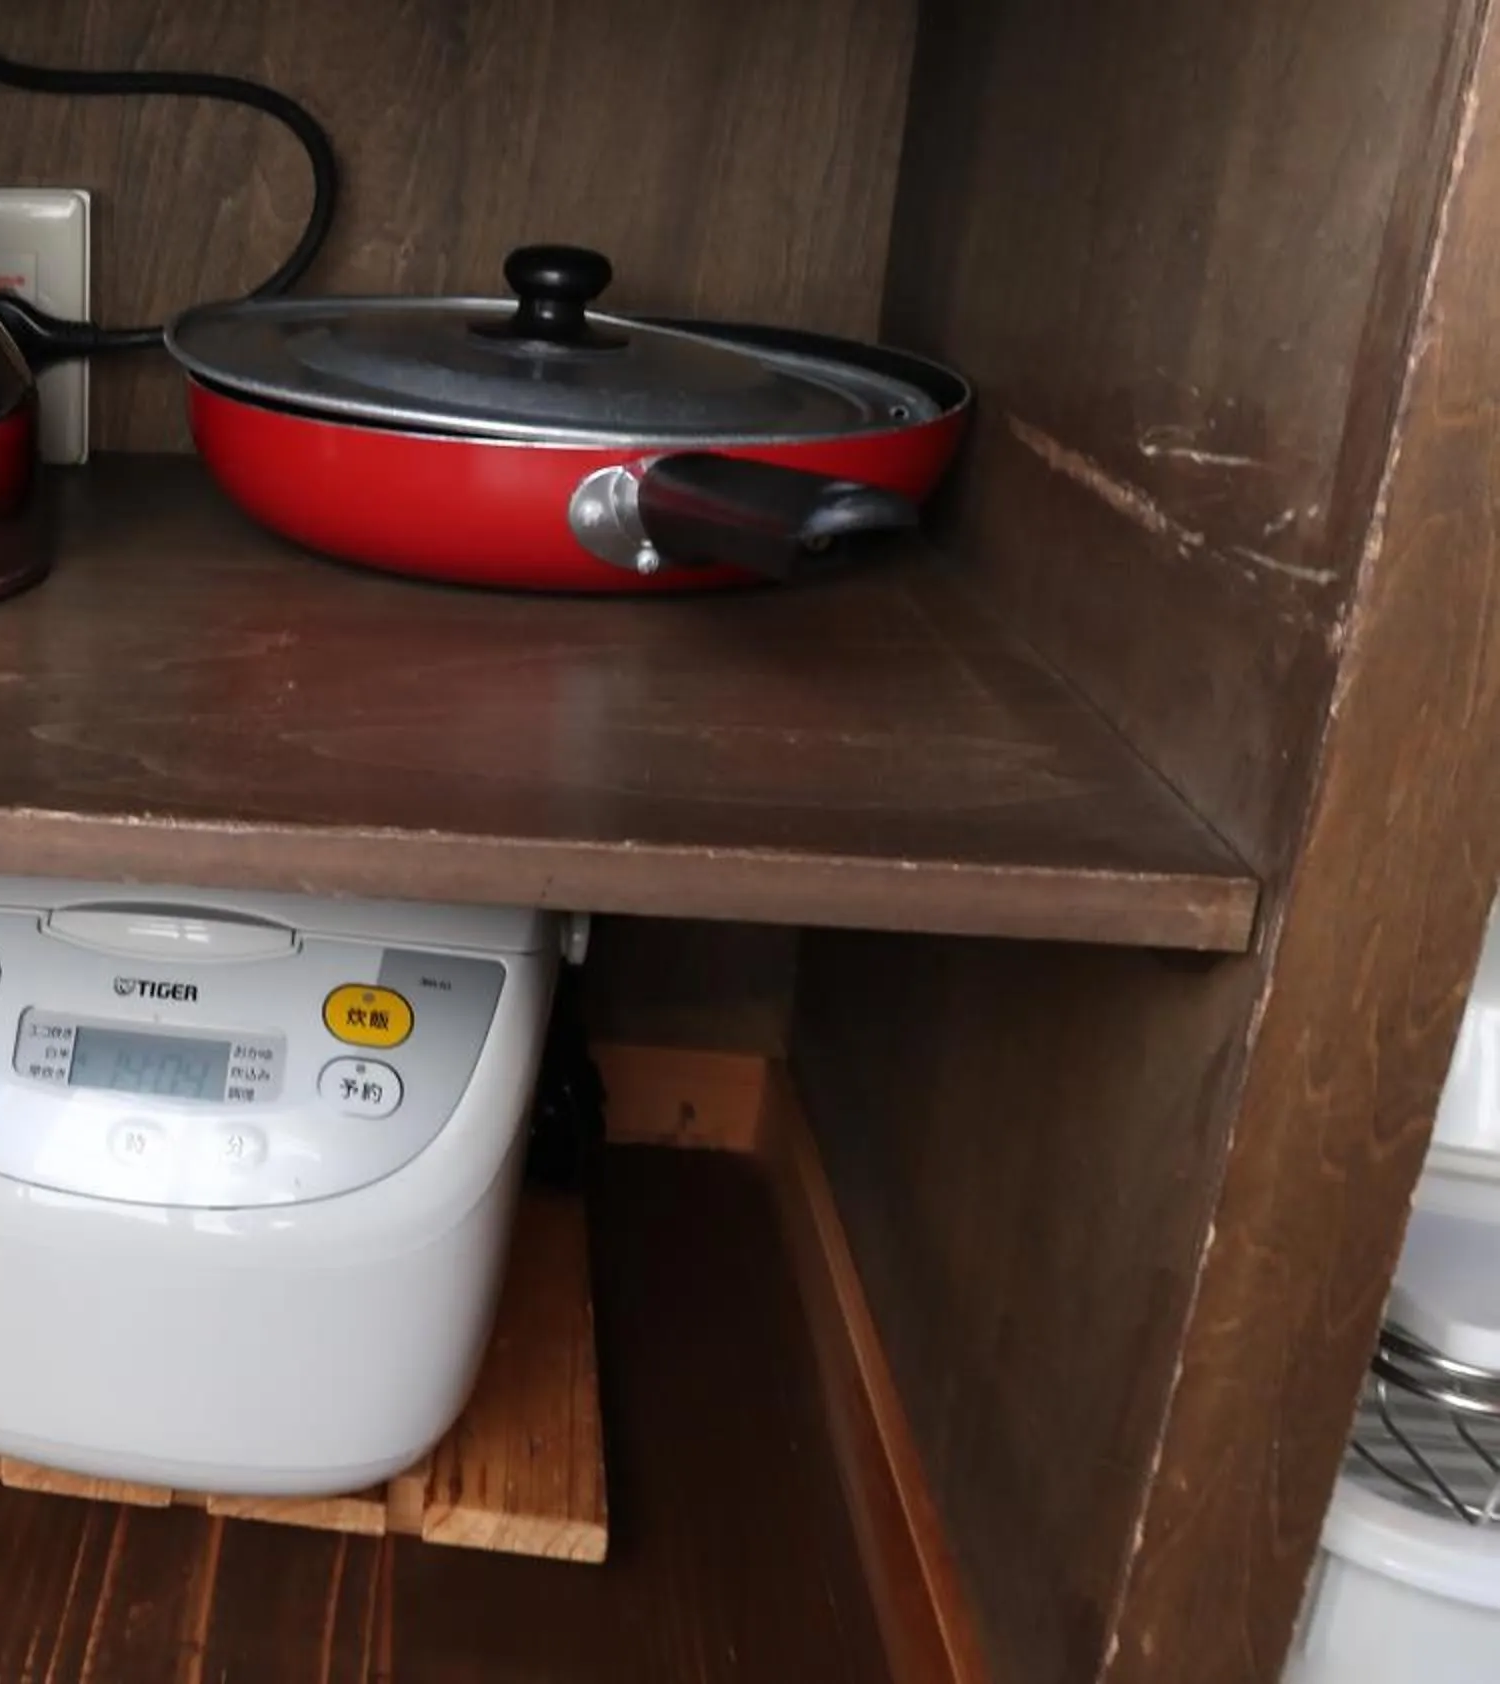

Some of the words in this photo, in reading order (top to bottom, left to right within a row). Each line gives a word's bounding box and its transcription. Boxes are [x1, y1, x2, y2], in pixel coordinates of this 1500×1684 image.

[139, 979, 199, 1002] TIGER
[346, 1006, 390, 1031] 炊飯
[340, 1077, 383, 1103] 予約
